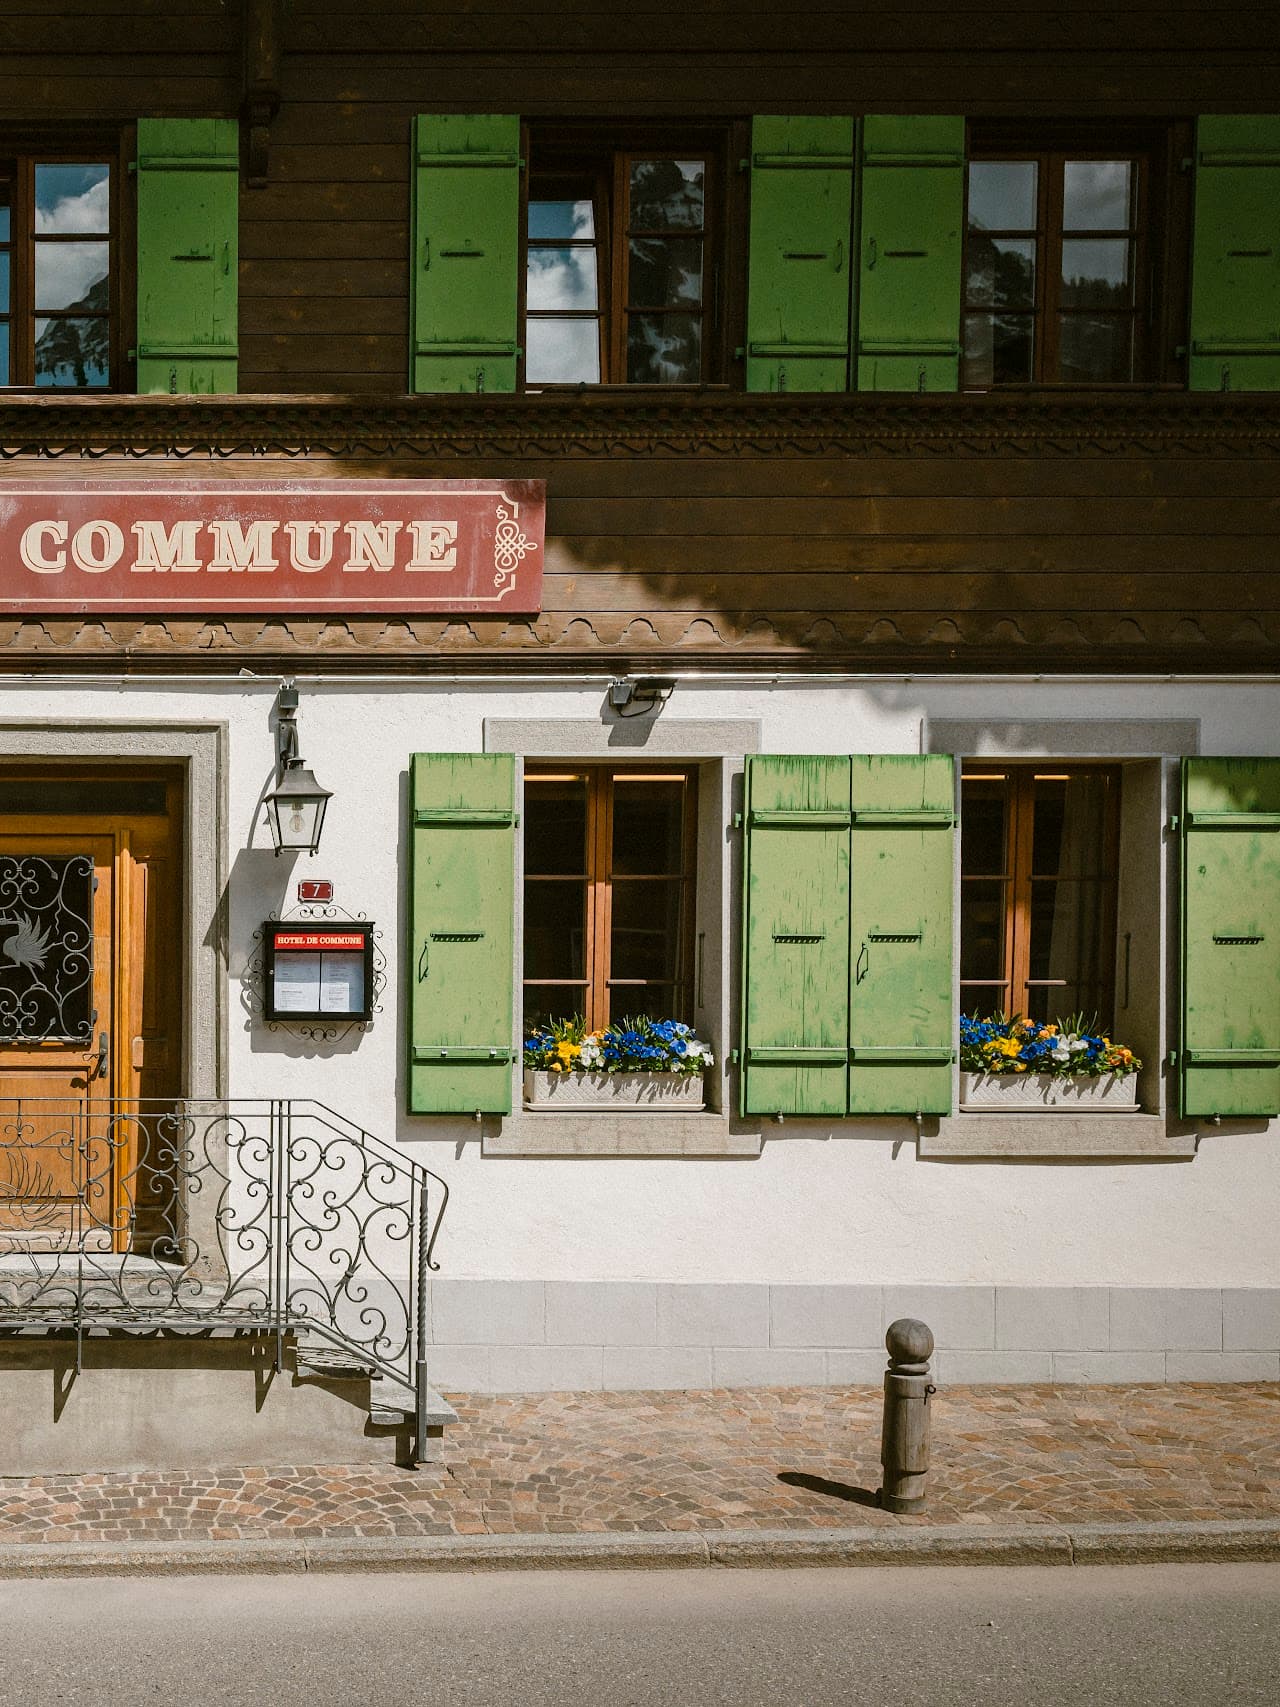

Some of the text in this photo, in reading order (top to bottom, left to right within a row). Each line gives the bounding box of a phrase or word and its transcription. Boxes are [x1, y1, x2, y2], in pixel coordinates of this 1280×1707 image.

[20, 519, 459, 573] COMMUNE
[313, 884, 321, 897] 7
[277, 936, 362, 945] HOTEL DE COMMUNE
